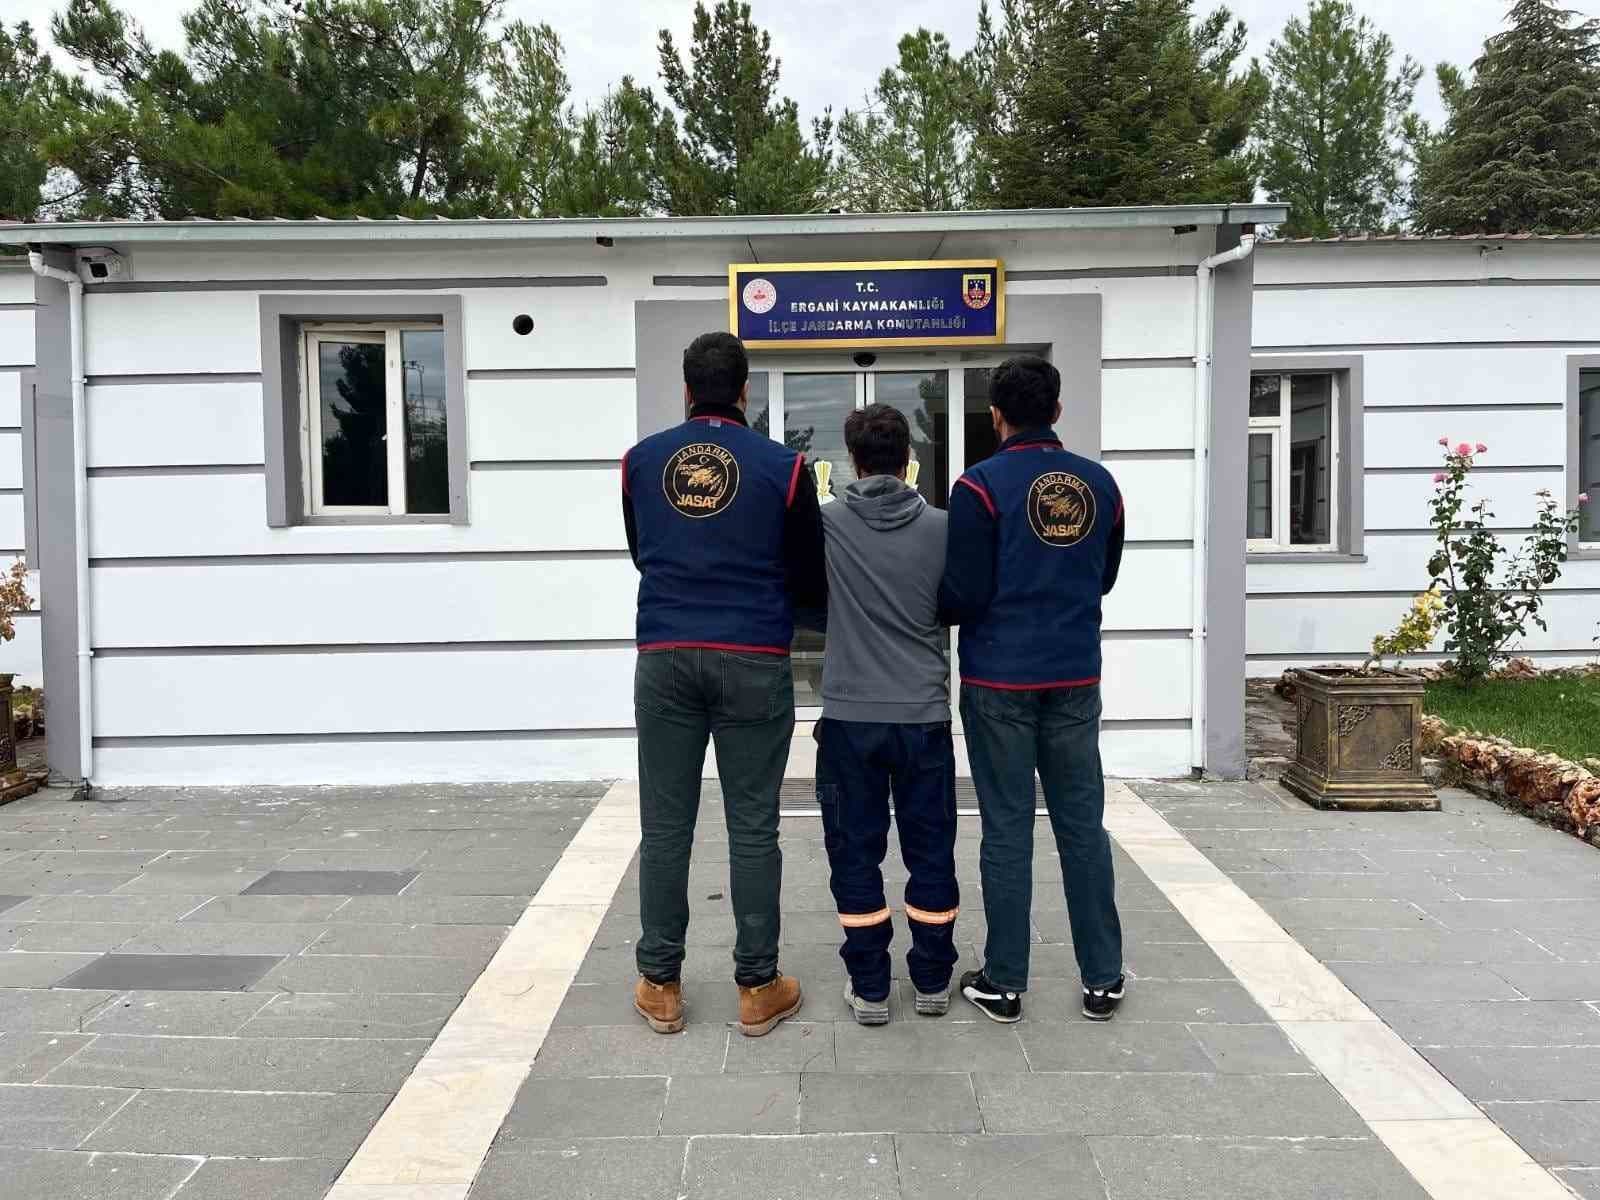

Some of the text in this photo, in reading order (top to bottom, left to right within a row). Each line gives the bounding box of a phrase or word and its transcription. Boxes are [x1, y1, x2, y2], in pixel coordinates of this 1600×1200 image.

[856, 282, 879, 293] T.C.
[791, 297, 944, 313] ERGANİ KAYMAKAMLIĞI
[769, 316, 966, 334] İLÇE JANDARMA KOMUTANLIĞI
[677, 446, 732, 465] JANDARMA
[1034, 475, 1086, 494] JANDARMA
[677, 494, 720, 509] JASAT
[1043, 524, 1081, 537] JASAT
